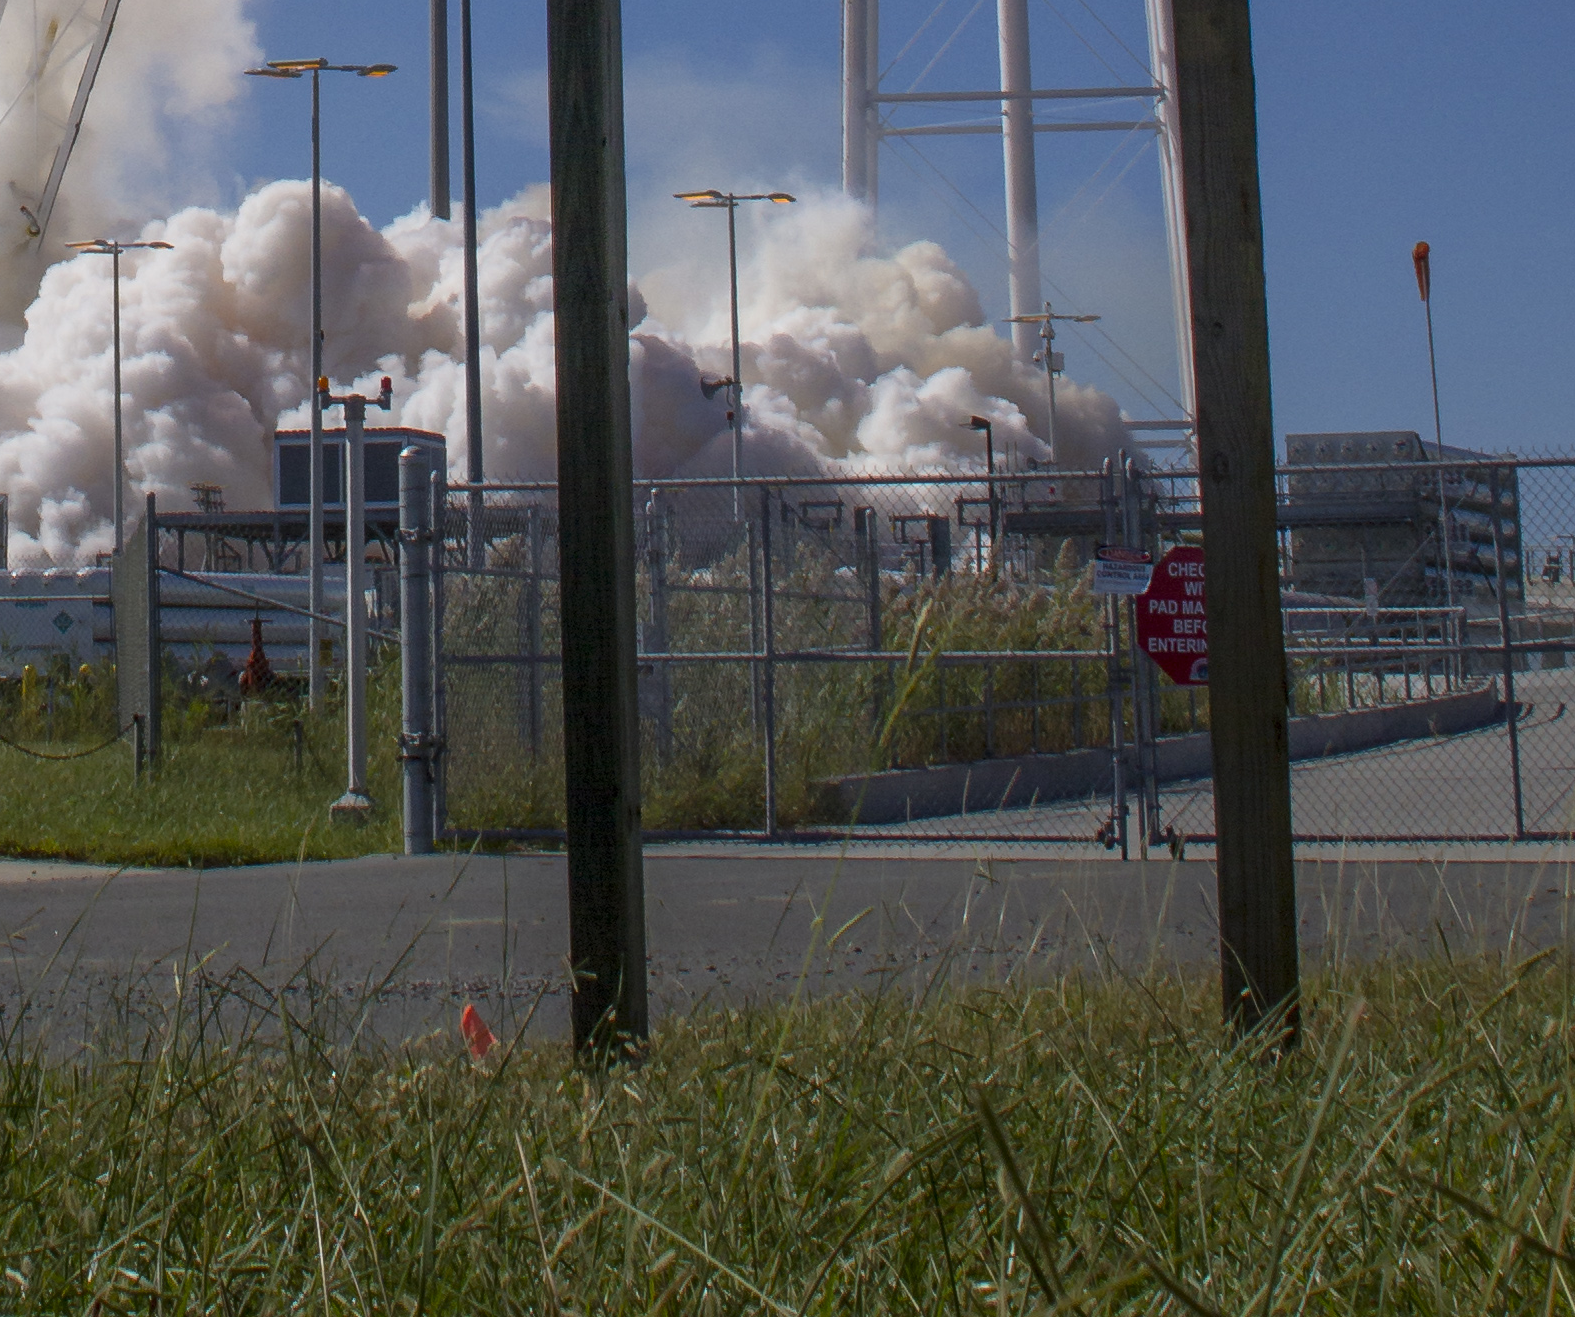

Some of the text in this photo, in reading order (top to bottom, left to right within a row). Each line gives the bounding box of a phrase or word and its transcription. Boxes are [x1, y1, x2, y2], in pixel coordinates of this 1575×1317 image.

[1168, 562, 1205, 578] CHEC
[1184, 581, 1205, 595] WI
[1149, 599, 1205, 615] PAD MA
[1148, 637, 1208, 653] ENTERIN
